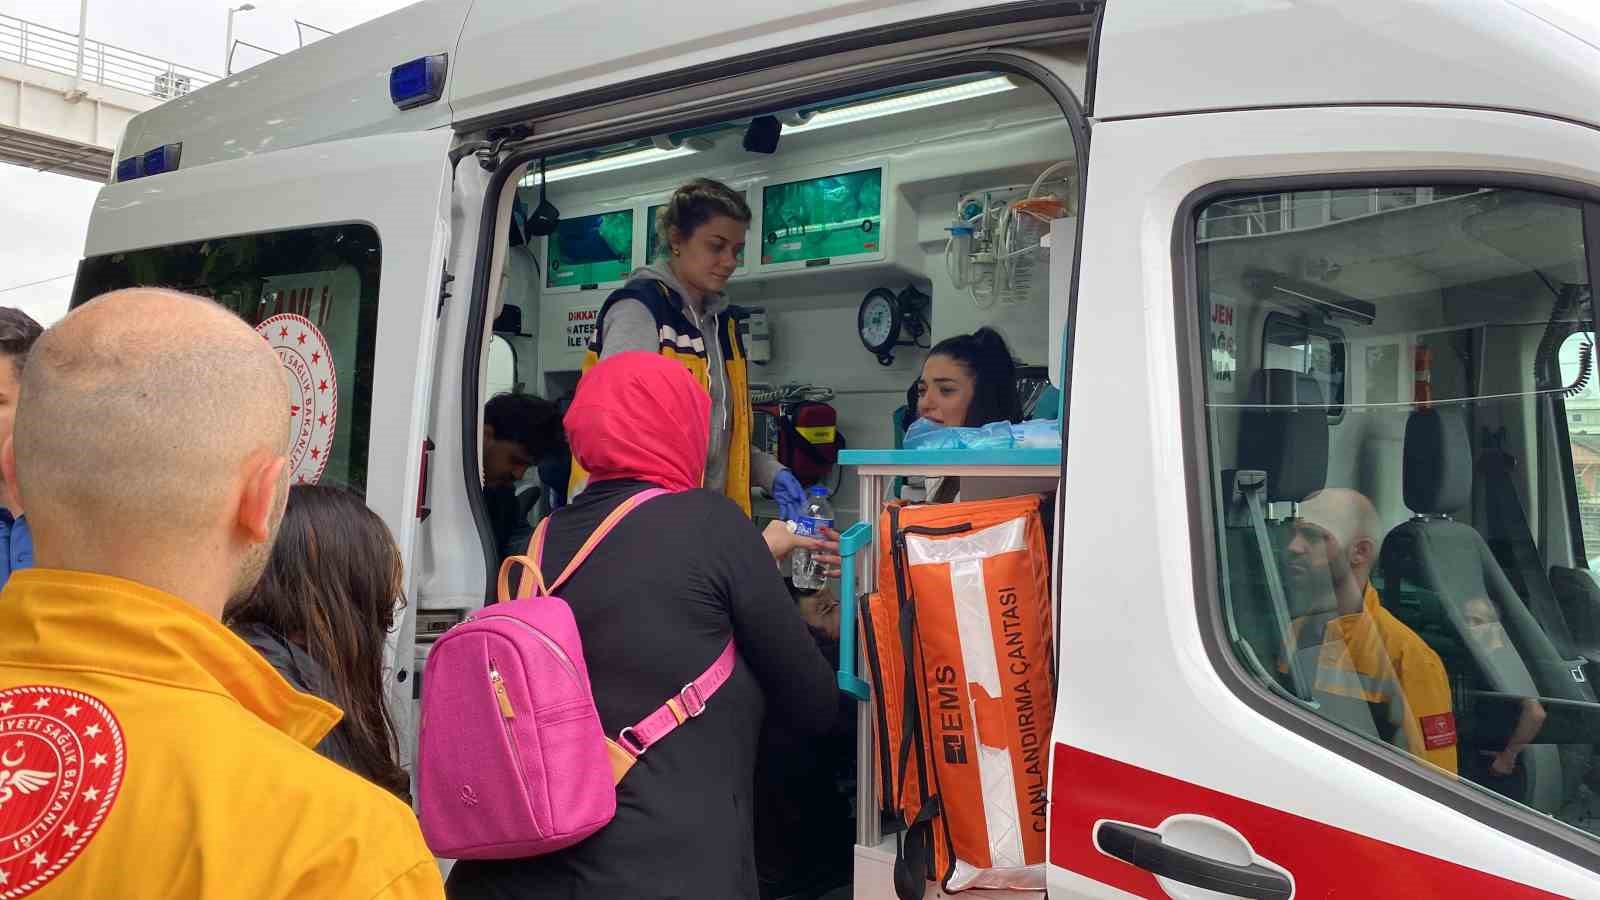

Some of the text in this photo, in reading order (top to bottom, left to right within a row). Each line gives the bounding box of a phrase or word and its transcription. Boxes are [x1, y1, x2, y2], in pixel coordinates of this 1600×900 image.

[935, 665, 964, 731] EMS
[998, 587, 1046, 832] CANLANDIRMA ÇANTASI
[43, 723, 77, 766] SAĞLIK
[12, 769, 77, 852] BAKANLIĞI
